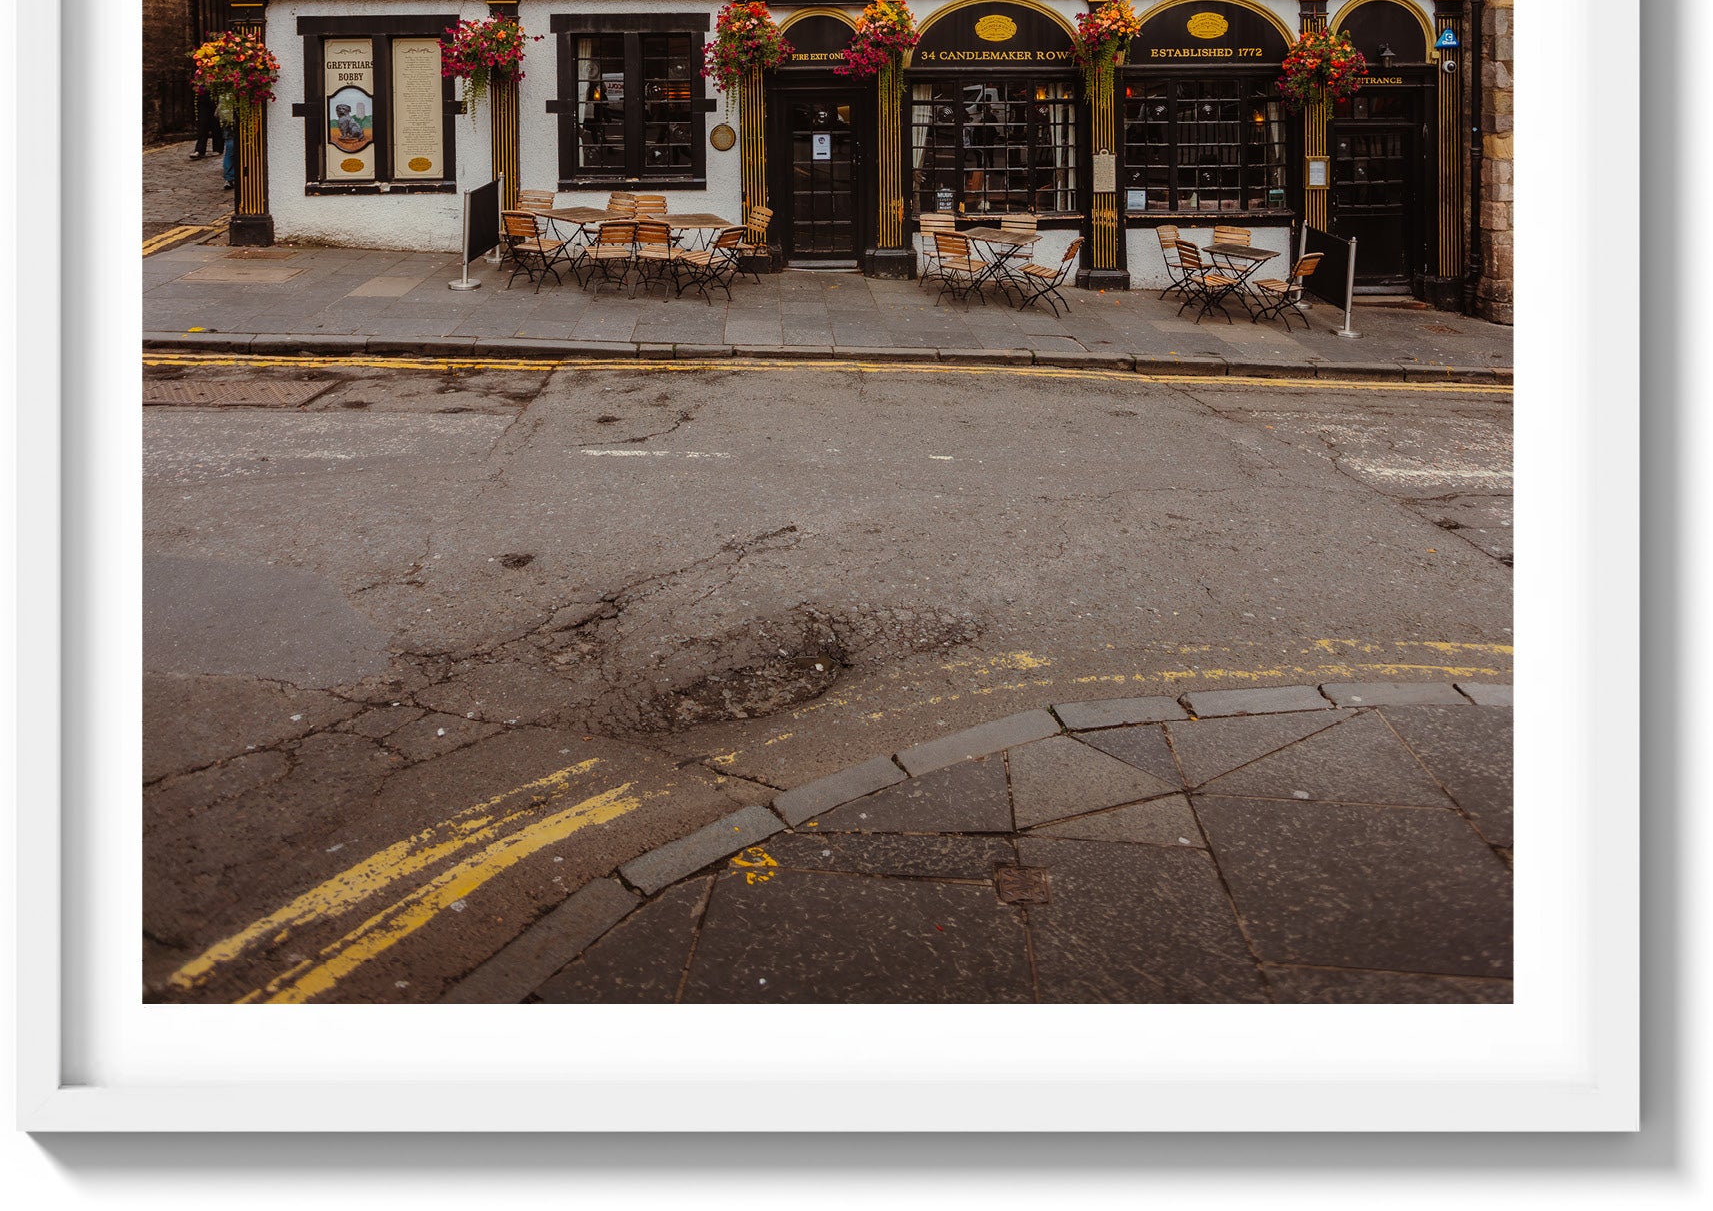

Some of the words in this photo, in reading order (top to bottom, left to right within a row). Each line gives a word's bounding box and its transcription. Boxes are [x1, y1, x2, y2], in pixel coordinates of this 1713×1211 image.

[791, 53, 809, 61] FIRE
[810, 53, 828, 61] EXIT
[829, 52, 846, 60] ONL
[921, 51, 936, 60] 34
[939, 51, 1032, 61] CANDLEMAKER
[1036, 50, 1070, 60] ROW
[1151, 48, 1233, 58] ESTABLISHED
[1238, 47, 1263, 57] 1772
[326, 60, 374, 70] GREYFRIARS
[338, 72, 364, 81] BOBBY
